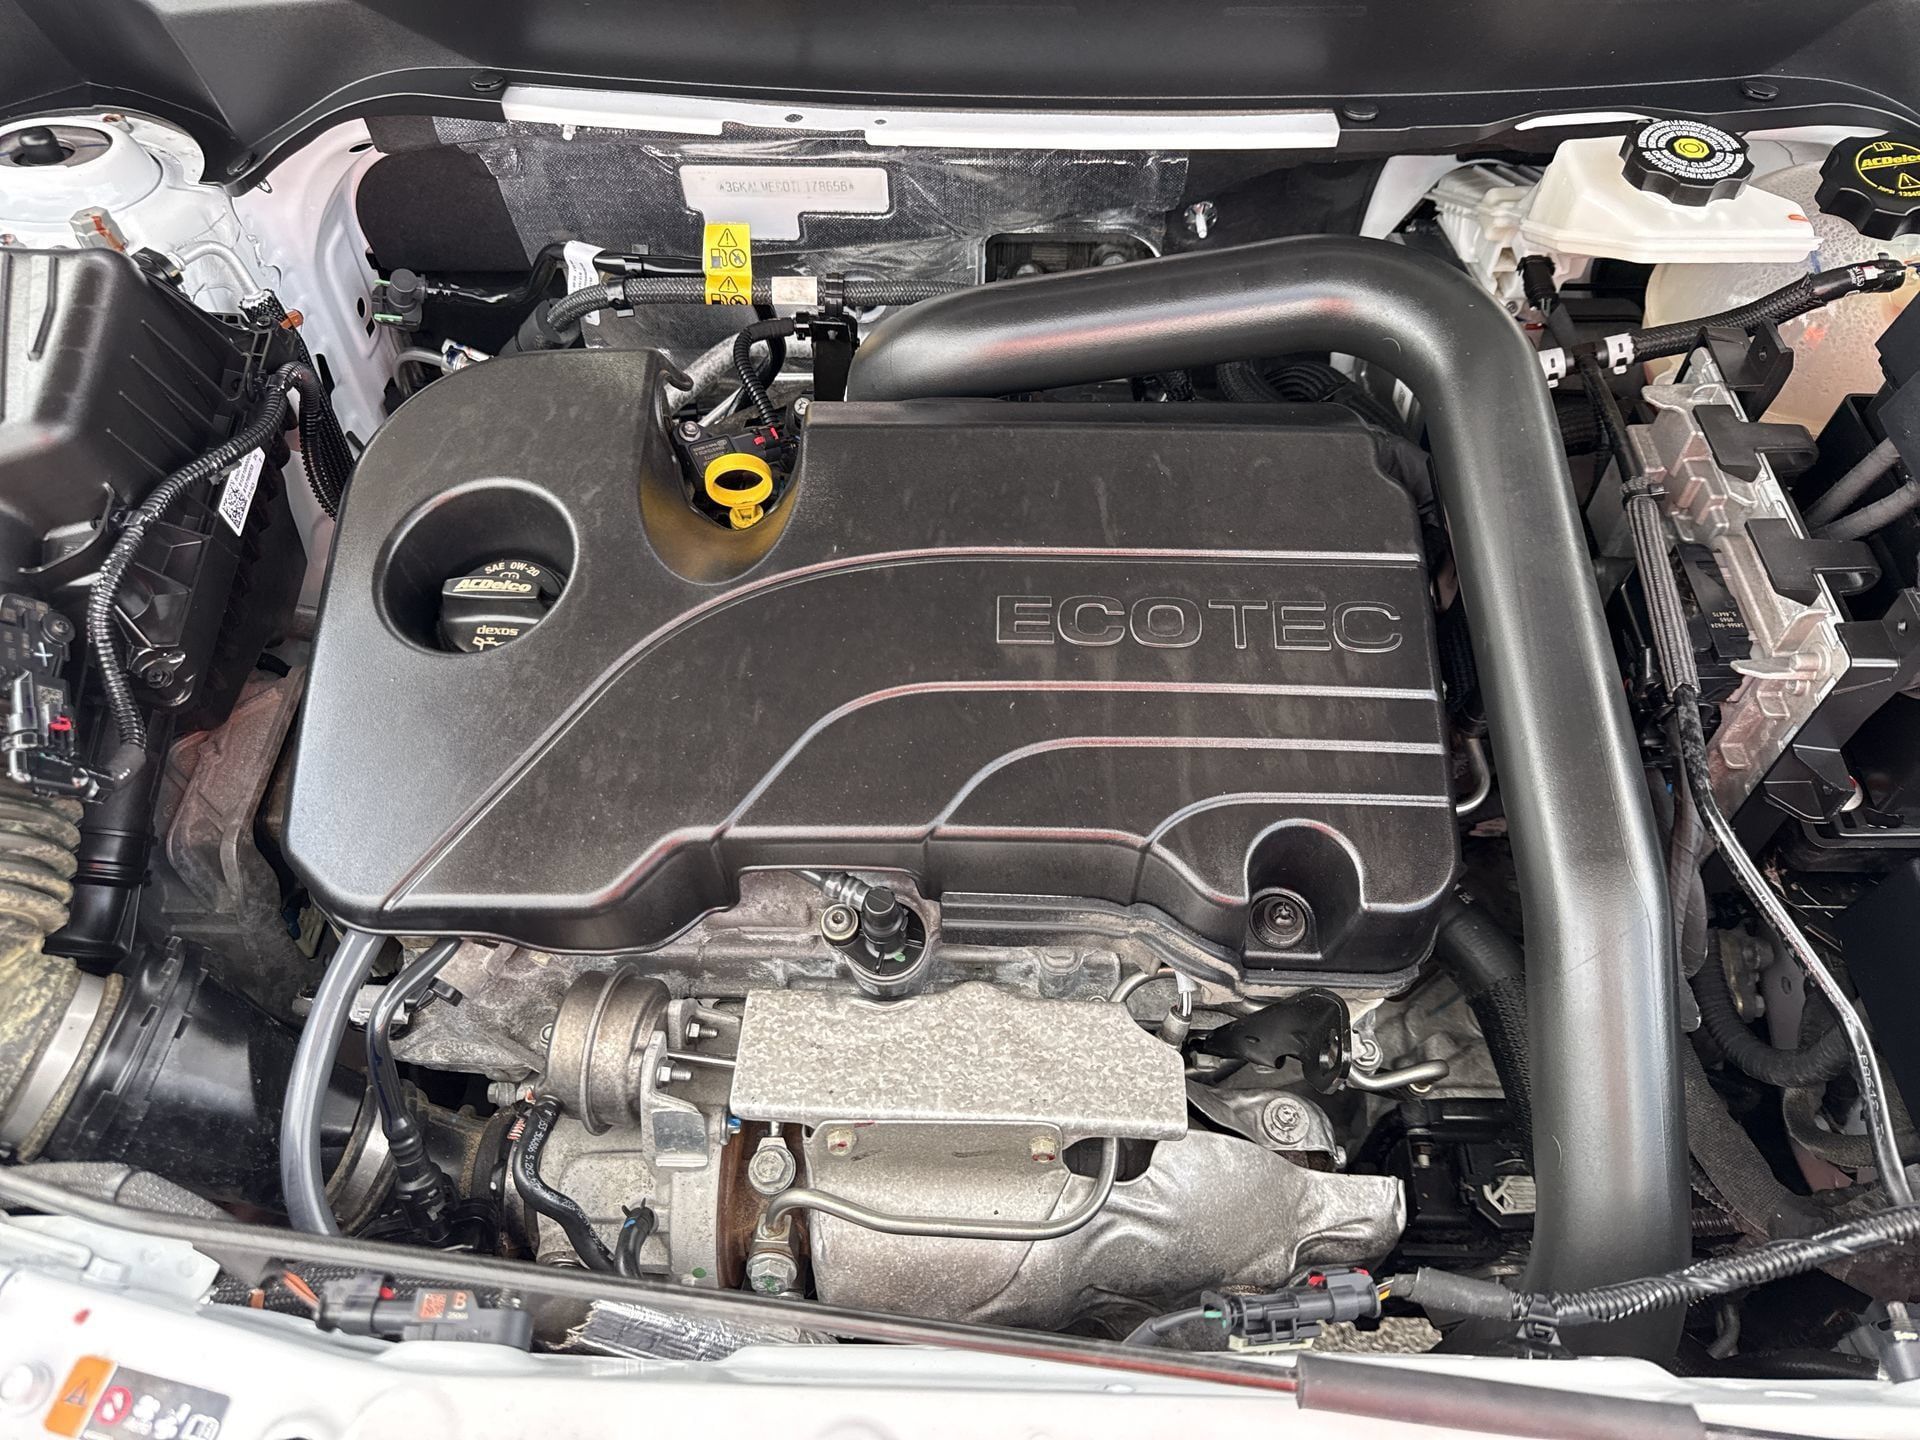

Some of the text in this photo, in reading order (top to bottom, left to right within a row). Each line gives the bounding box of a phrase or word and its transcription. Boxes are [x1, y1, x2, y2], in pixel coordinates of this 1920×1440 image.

[484, 562, 540, 577] SAE 0W-20
[453, 579, 532, 592] ACDelco
[476, 625, 520, 636] dexos
[996, 595, 1403, 654] ECOTEC
[453, 1291, 467, 1310] B
